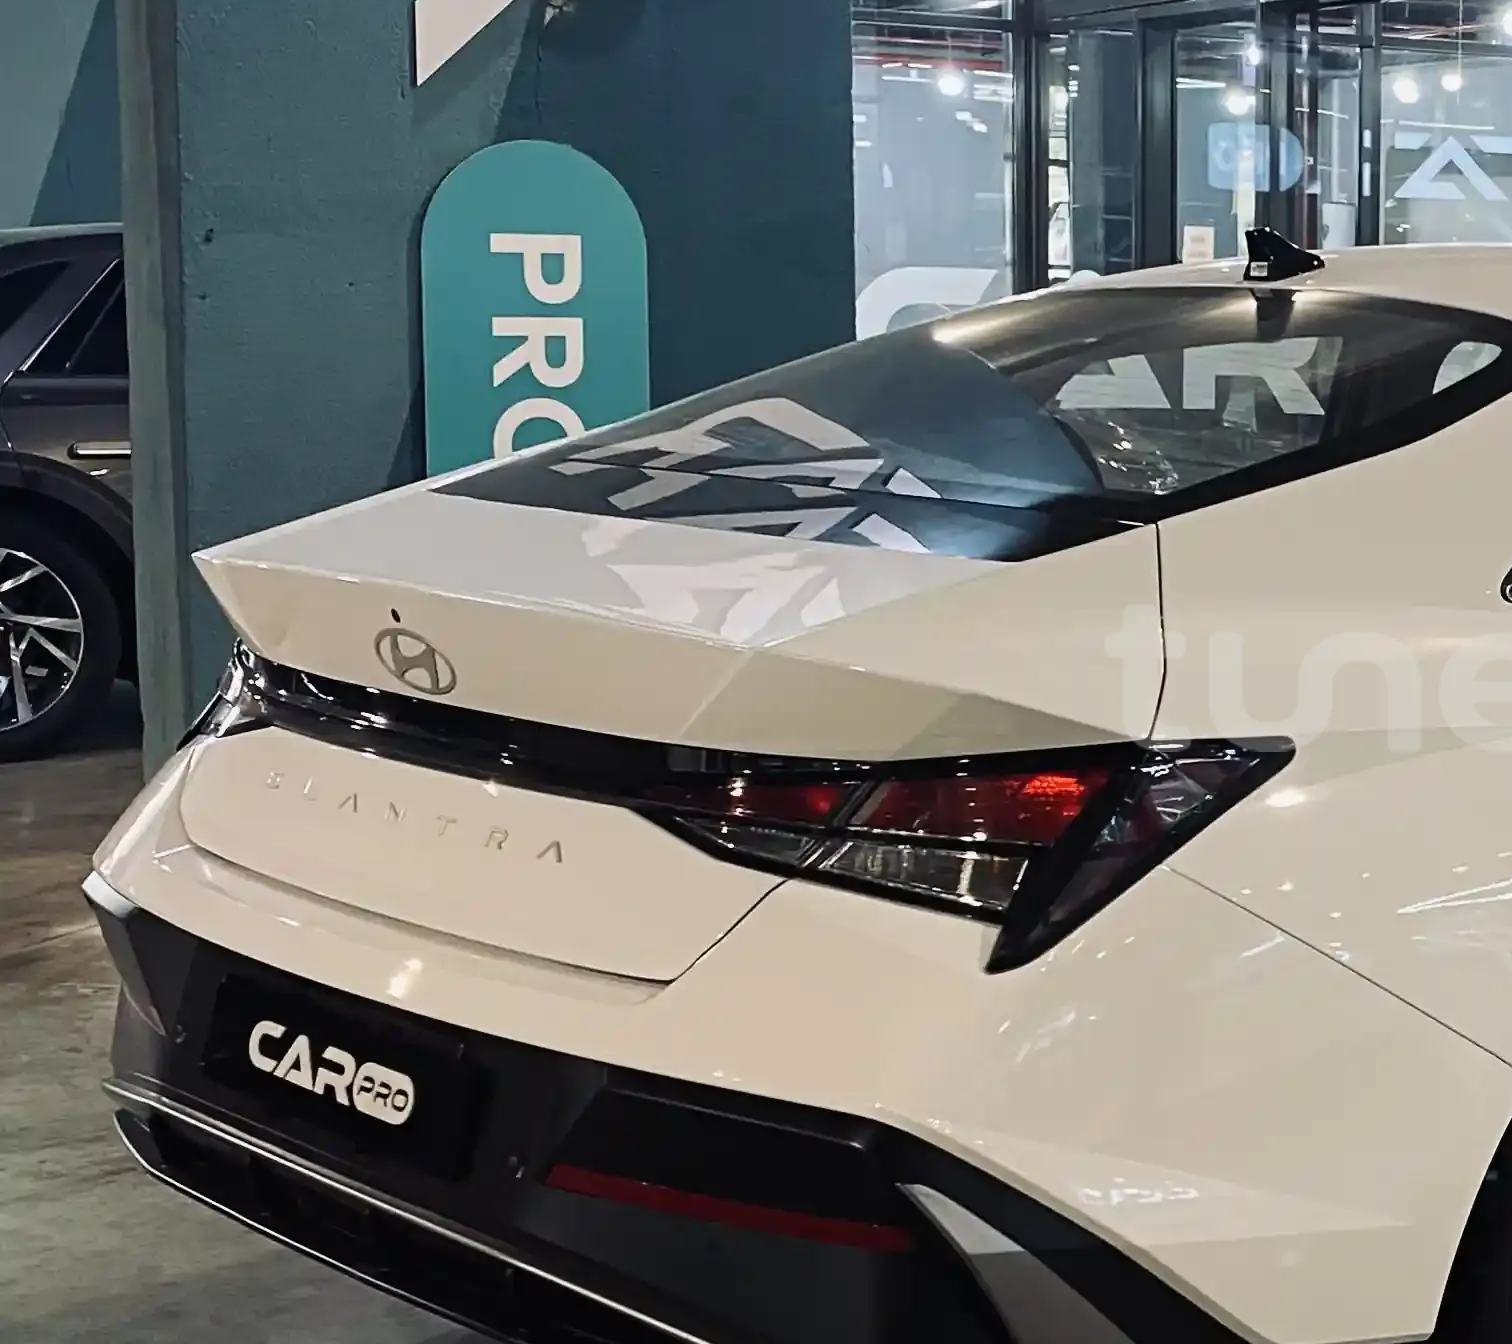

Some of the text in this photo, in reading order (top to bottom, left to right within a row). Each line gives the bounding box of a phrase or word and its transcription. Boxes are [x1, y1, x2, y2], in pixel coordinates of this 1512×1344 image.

[264, 771, 564, 864] ELANTRA
[248, 1019, 411, 1113] CAR PRO
